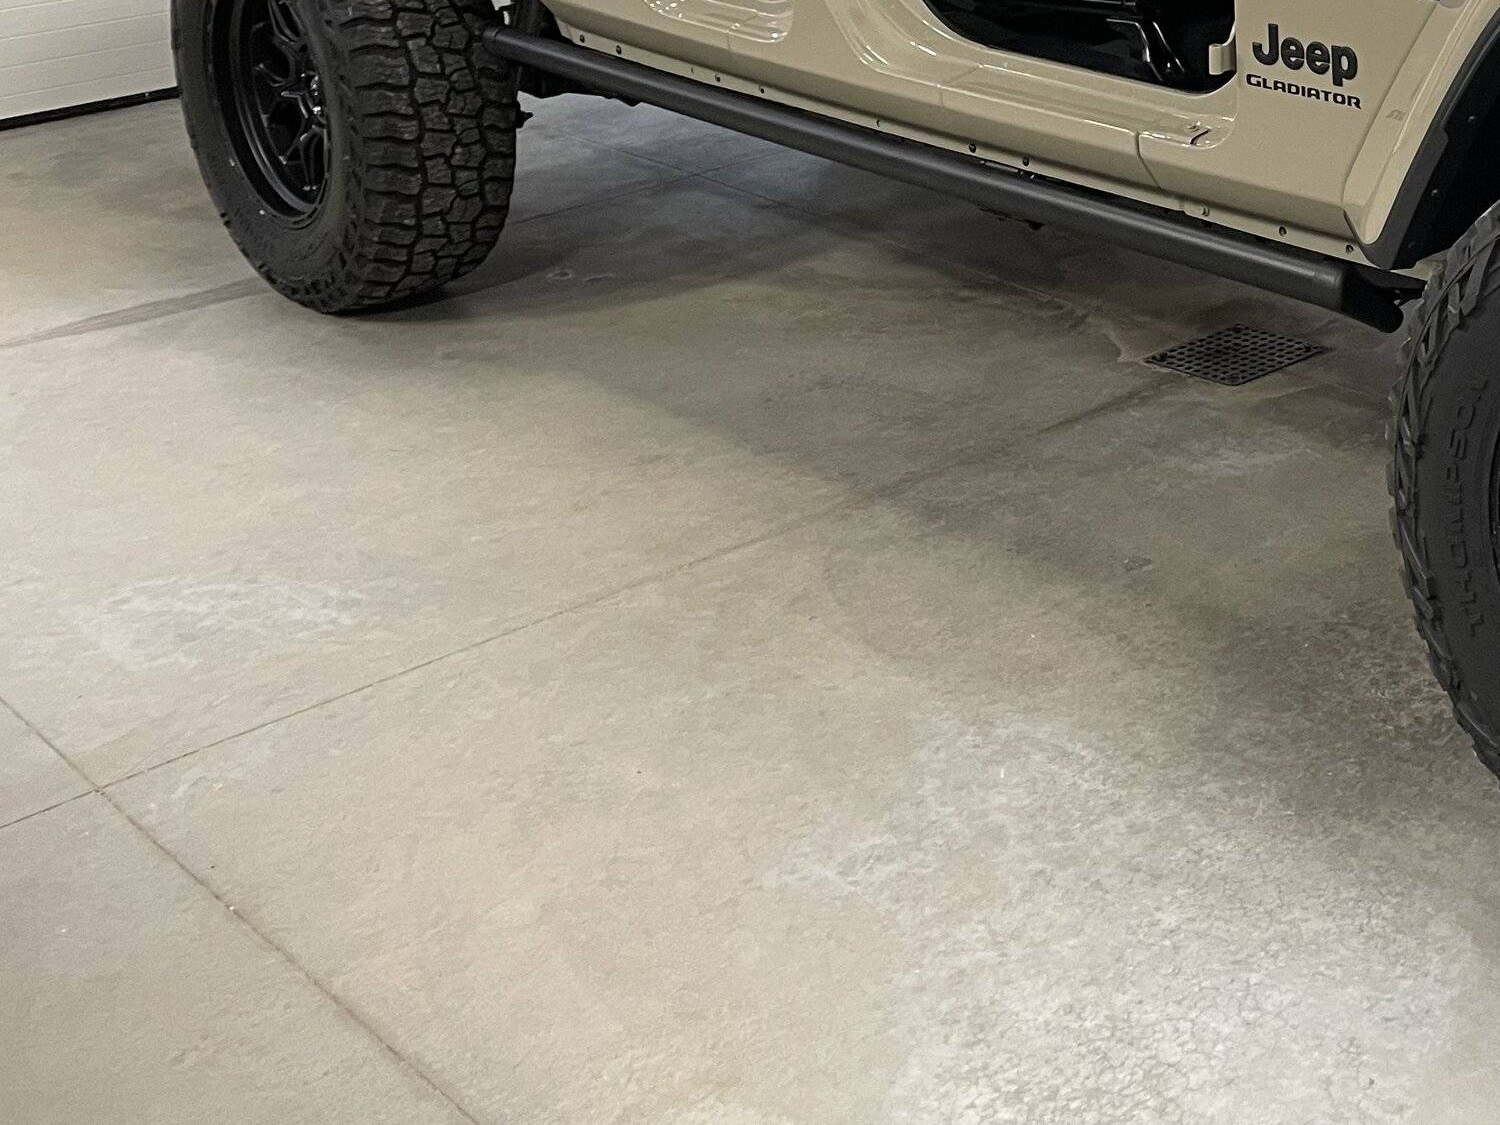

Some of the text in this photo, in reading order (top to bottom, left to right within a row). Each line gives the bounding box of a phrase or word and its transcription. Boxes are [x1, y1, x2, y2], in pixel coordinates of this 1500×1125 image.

[1252, 23, 1358, 87] Jeep
[1246, 73, 1361, 109] GLADIATOR
[1442, 375, 1490, 638] THOMPSON
